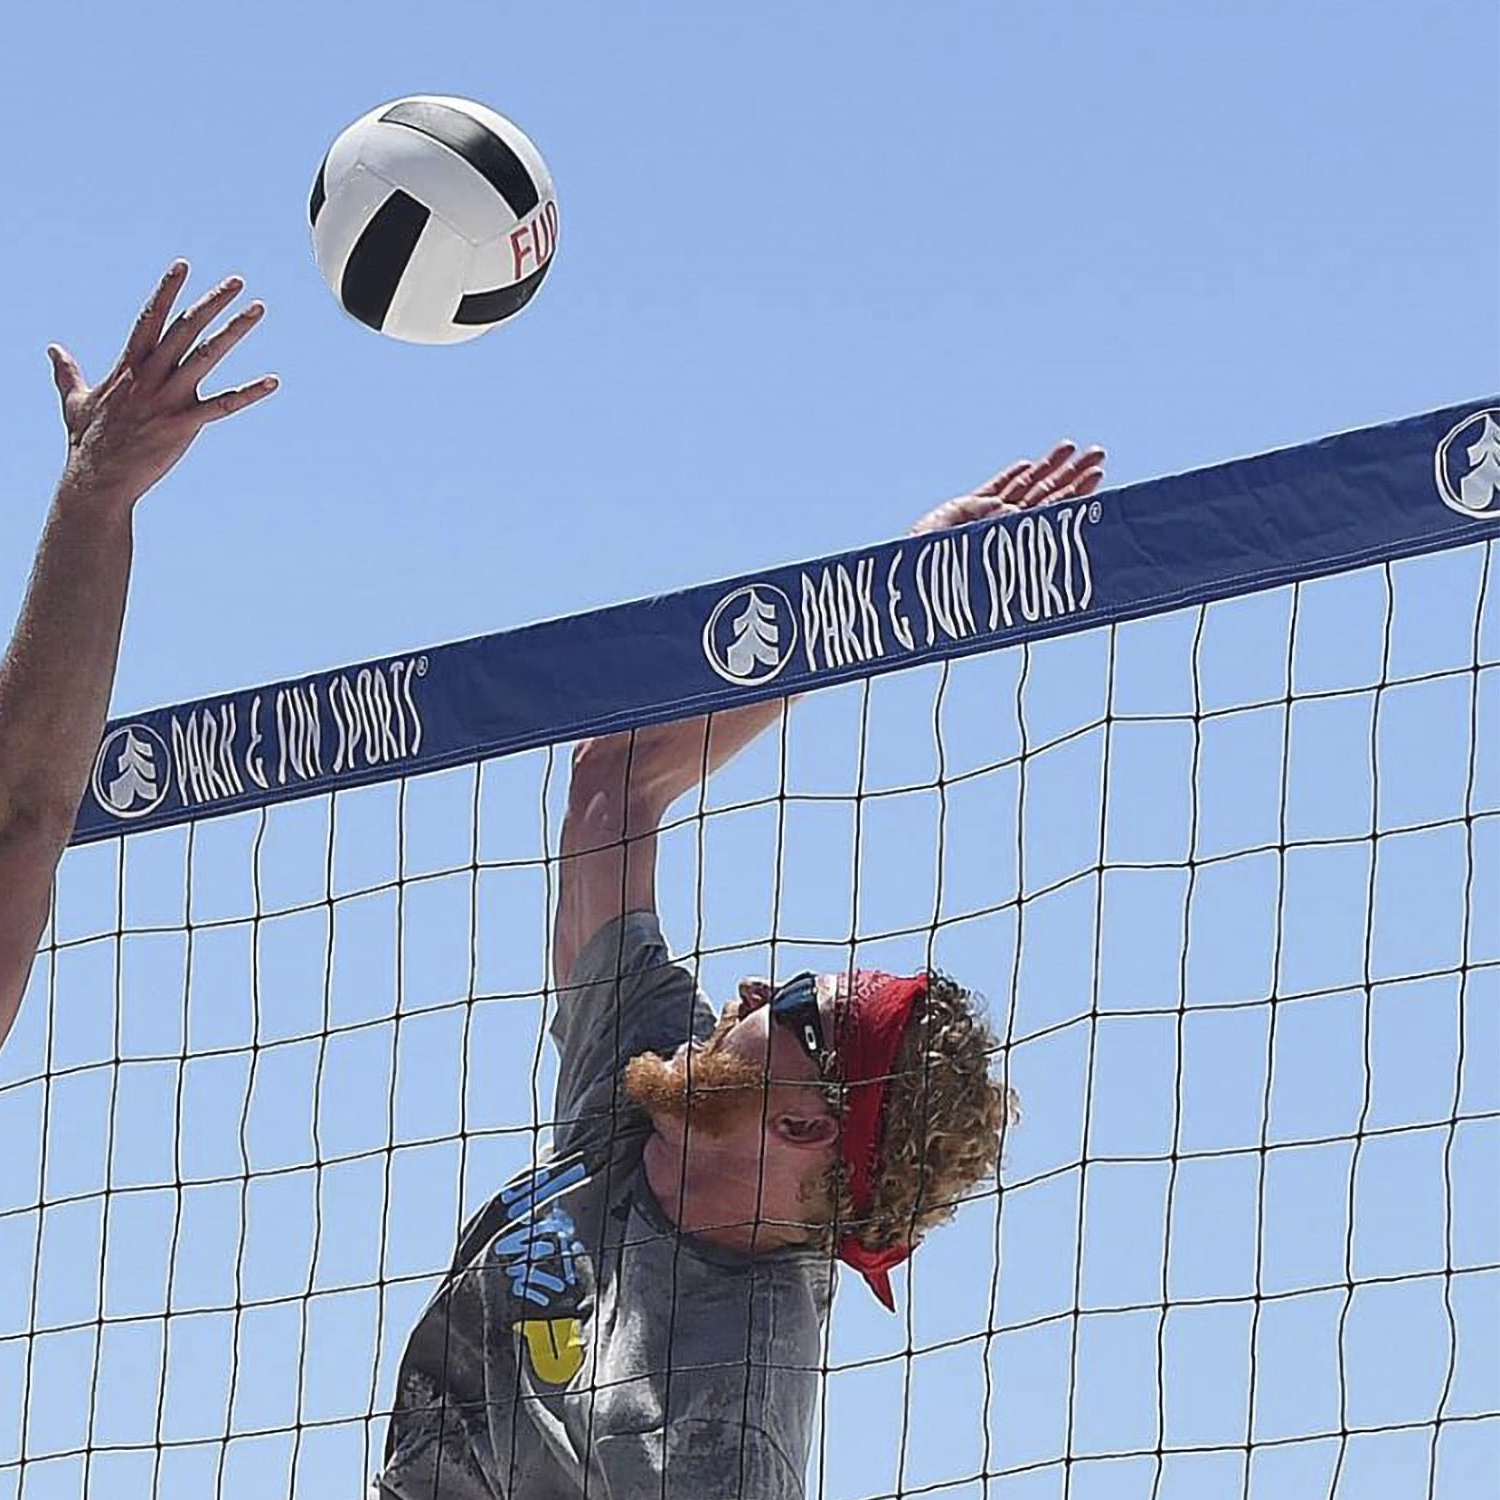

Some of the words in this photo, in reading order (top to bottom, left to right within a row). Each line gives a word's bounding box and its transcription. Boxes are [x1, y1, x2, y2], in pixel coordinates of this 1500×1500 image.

[801, 557, 884, 672] PARK
[915, 533, 977, 646] SUN
[982, 503, 1092, 631] SPORTS
[171, 702, 244, 806] PARK
[275, 682, 324, 784] SUN
[329, 657, 422, 773] SPORTS
